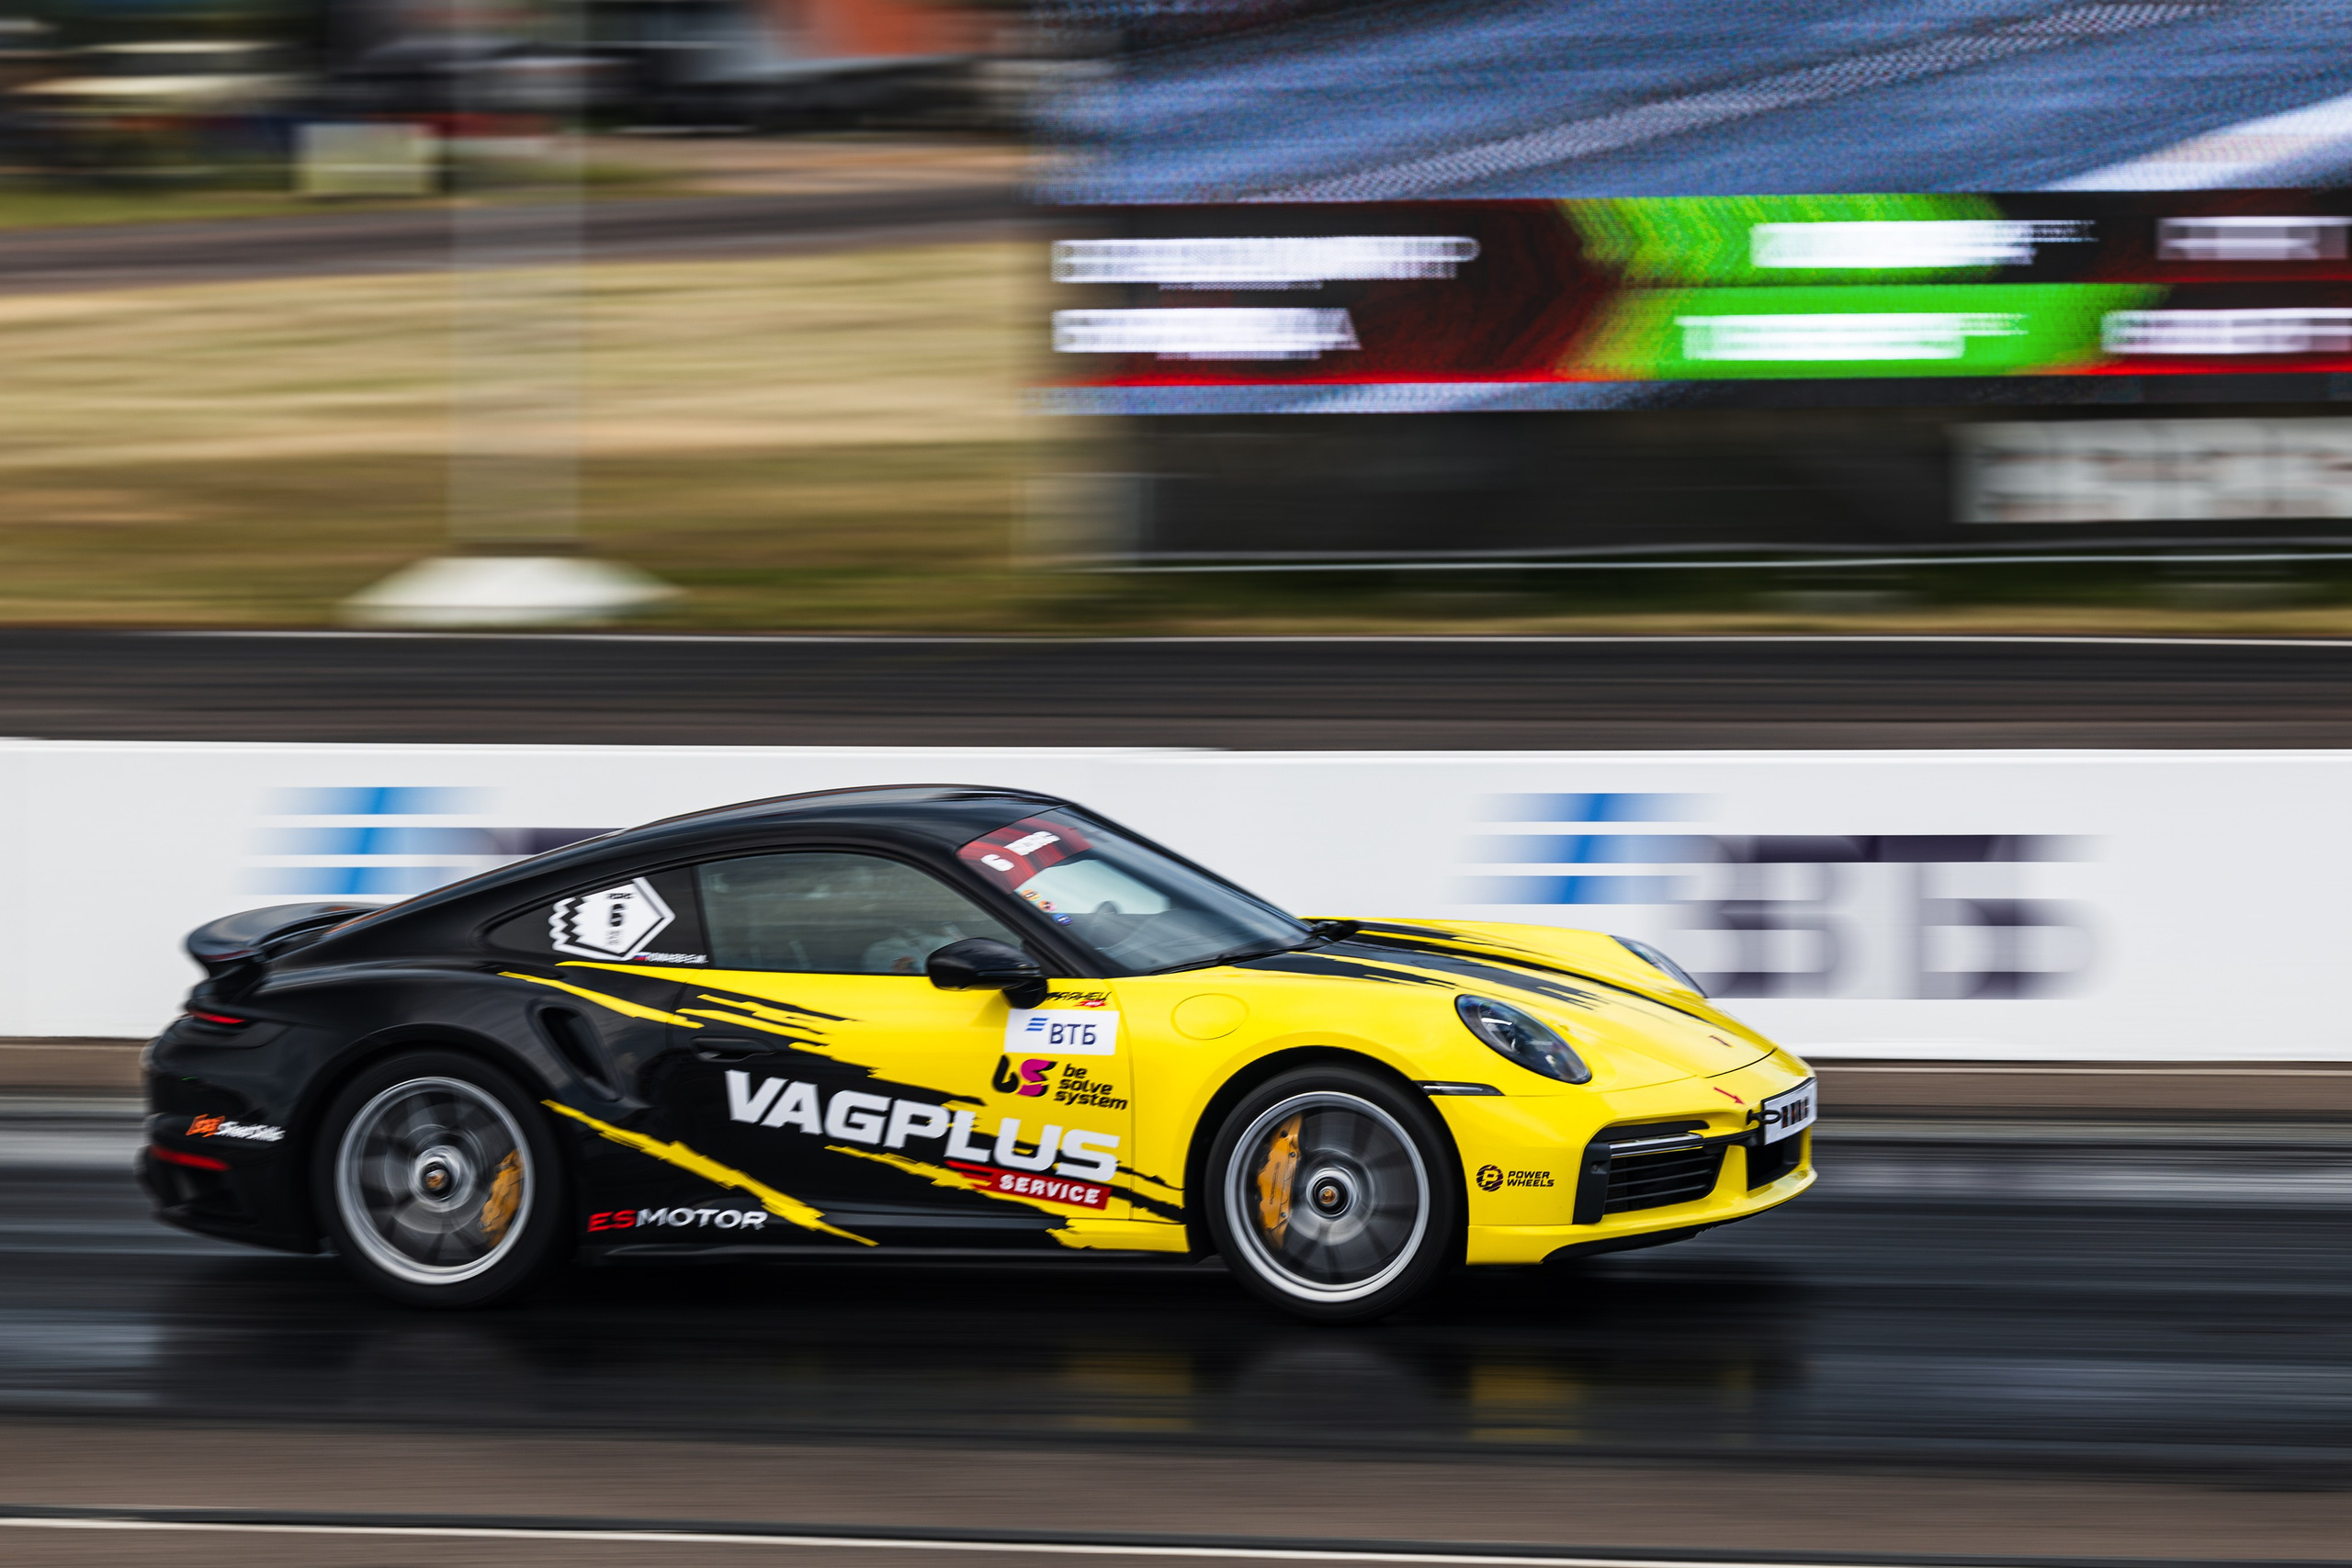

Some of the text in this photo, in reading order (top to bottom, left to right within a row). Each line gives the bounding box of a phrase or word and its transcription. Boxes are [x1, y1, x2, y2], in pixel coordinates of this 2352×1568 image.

[608, 903, 626, 928] 6
[1048, 1022, 1098, 1045] ВТБ
[1062, 1063, 1088, 1079] be
[1057, 1078, 1114, 1096] solve
[1054, 1090, 1129, 1111] system
[724, 1068, 1120, 1183] VAGPLUS
[1507, 1179, 1555, 1187] WHEELS
[1508, 1170, 1551, 1179] POWER
[998, 1173, 1102, 1205] SERVICE
[587, 1207, 769, 1233] ESMOTOR
